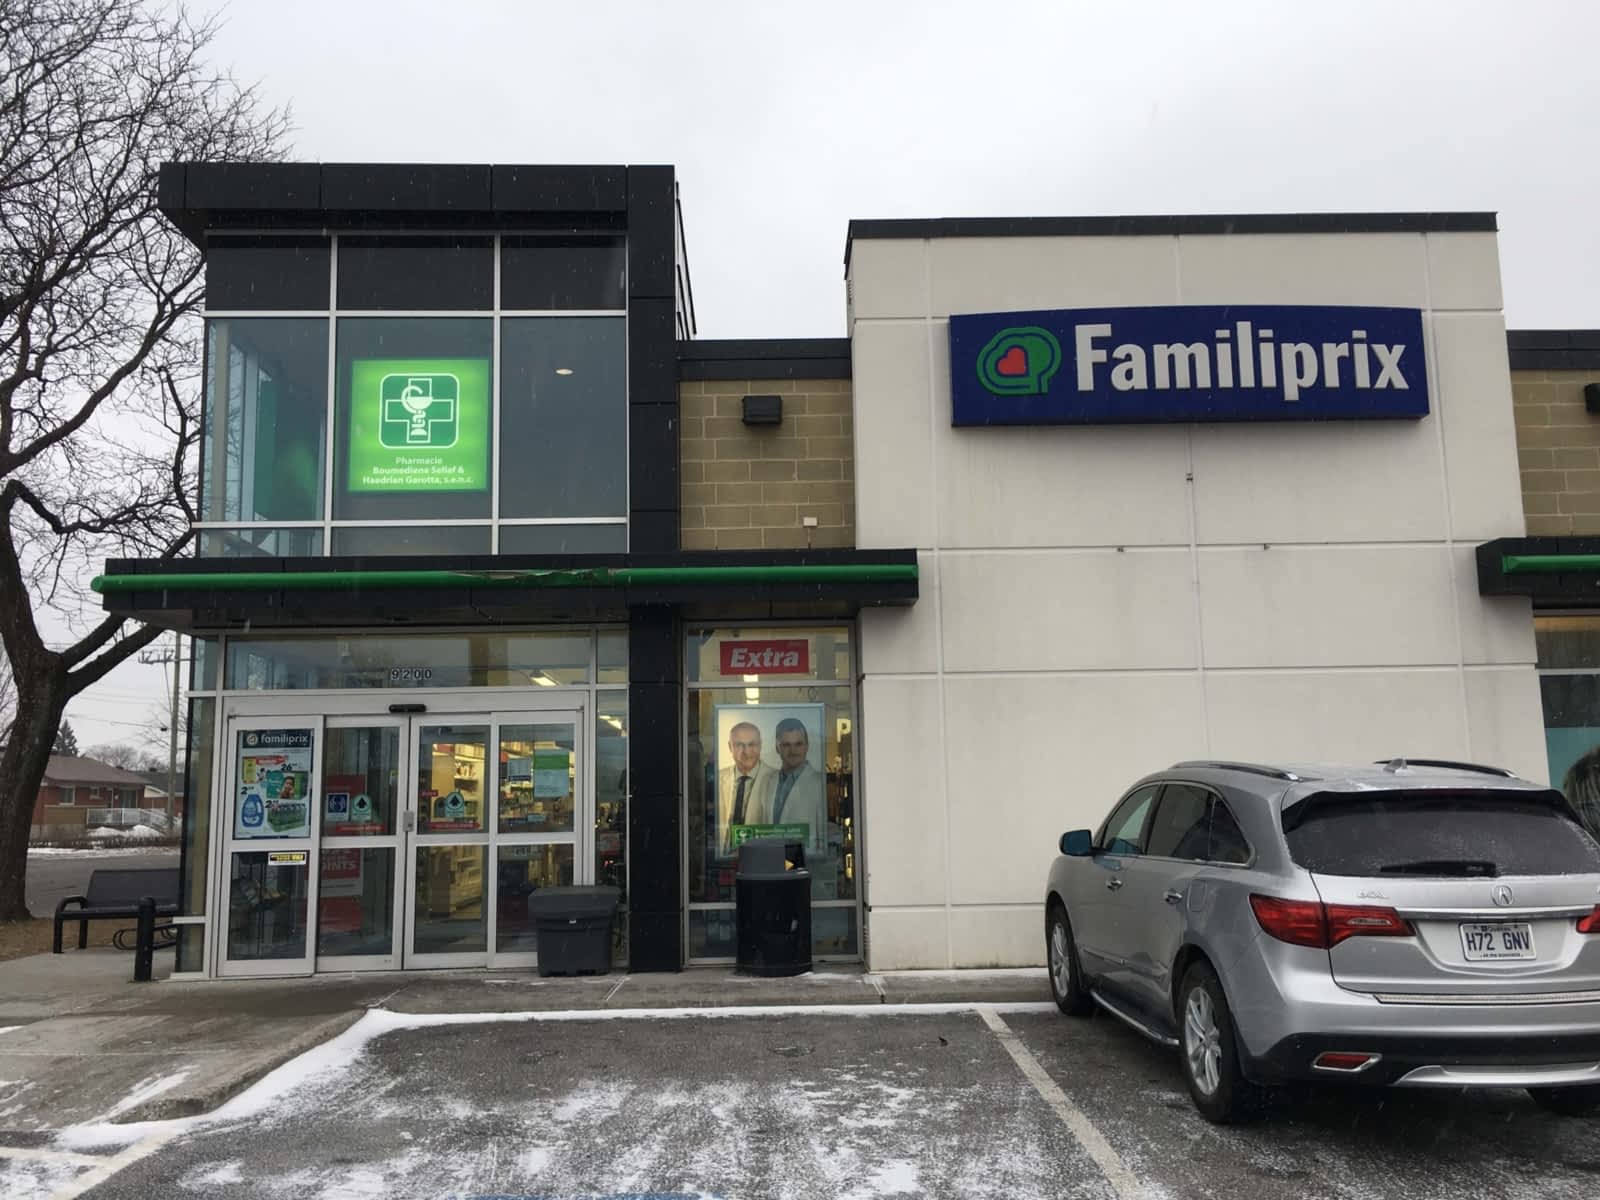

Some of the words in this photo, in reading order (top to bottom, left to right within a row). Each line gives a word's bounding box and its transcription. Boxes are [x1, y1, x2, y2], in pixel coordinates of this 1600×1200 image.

[1074, 320, 1409, 401] Familiprix
[395, 456, 443, 465] Pharmacie
[730, 647, 800, 669] Extra
[391, 668, 433, 680] 9200
[260, 733, 309, 745] familiprix
[1465, 932, 1496, 951] H72
[1502, 931, 1530, 951] GNV
